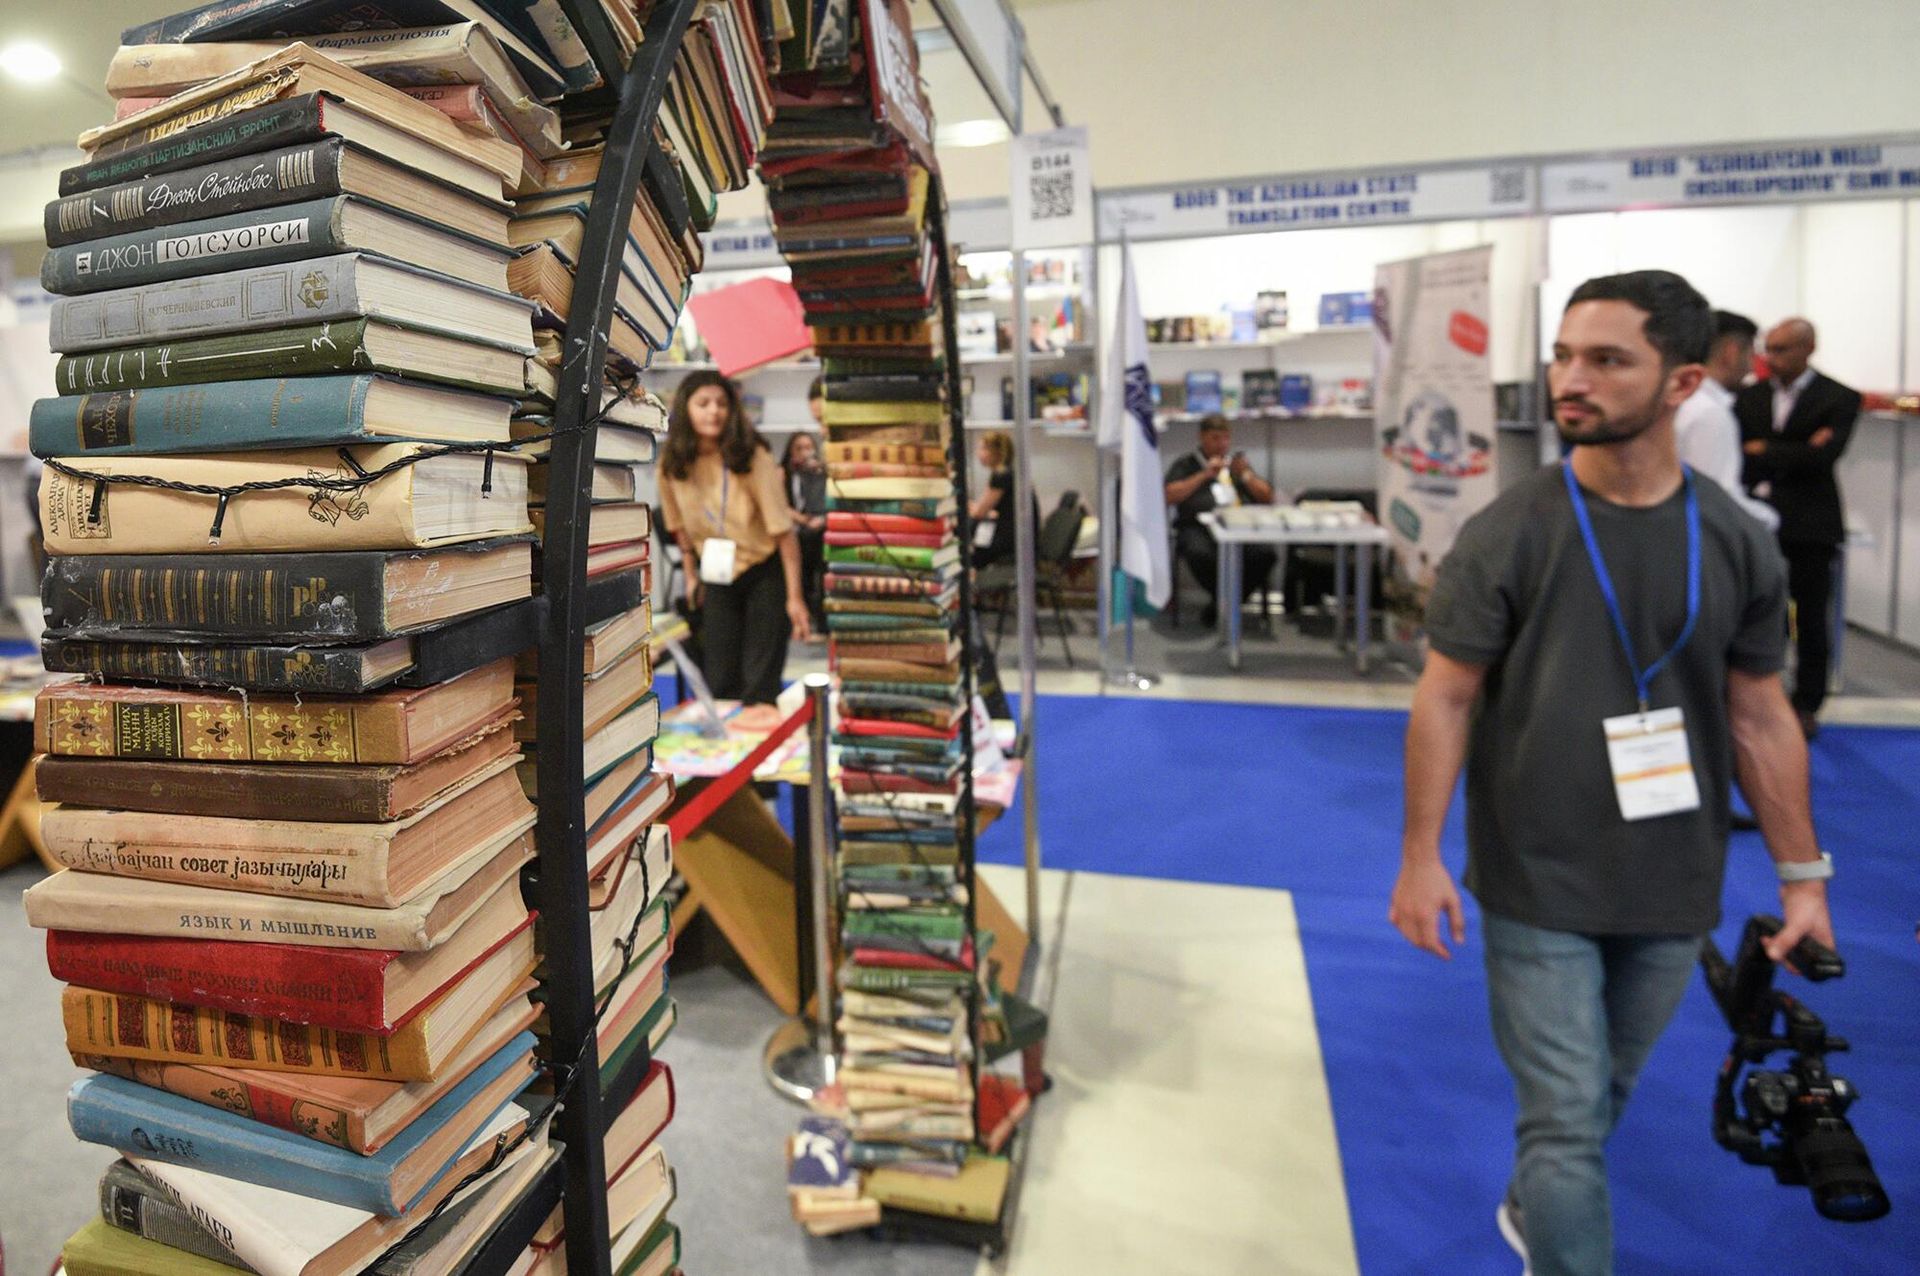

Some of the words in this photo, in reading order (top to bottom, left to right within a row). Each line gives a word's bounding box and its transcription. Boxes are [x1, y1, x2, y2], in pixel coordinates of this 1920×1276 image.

[146, 182, 198, 211] Джон
[198, 163, 273, 203] Стейнбек
[95, 242, 154, 276] ДЖОН
[164, 220, 303, 261] ГОЛСУОРСИ
[56, 483, 68, 523] ДЮМА
[122, 705, 131, 753] ГЕНРИХ
[131, 712, 141, 750] МАНН
[144, 706, 152, 752] МОЛОДЫЕ
[157, 711, 165, 748] КОРОЛЯ
[164, 714, 172, 756] ГЕНРИХА
[180, 856, 229, 875] совет
[180, 914, 233, 931] ЯЗЫК
[240, 918, 252, 932] И
[260, 919, 377, 940] МЫШЛЕНИЕ
